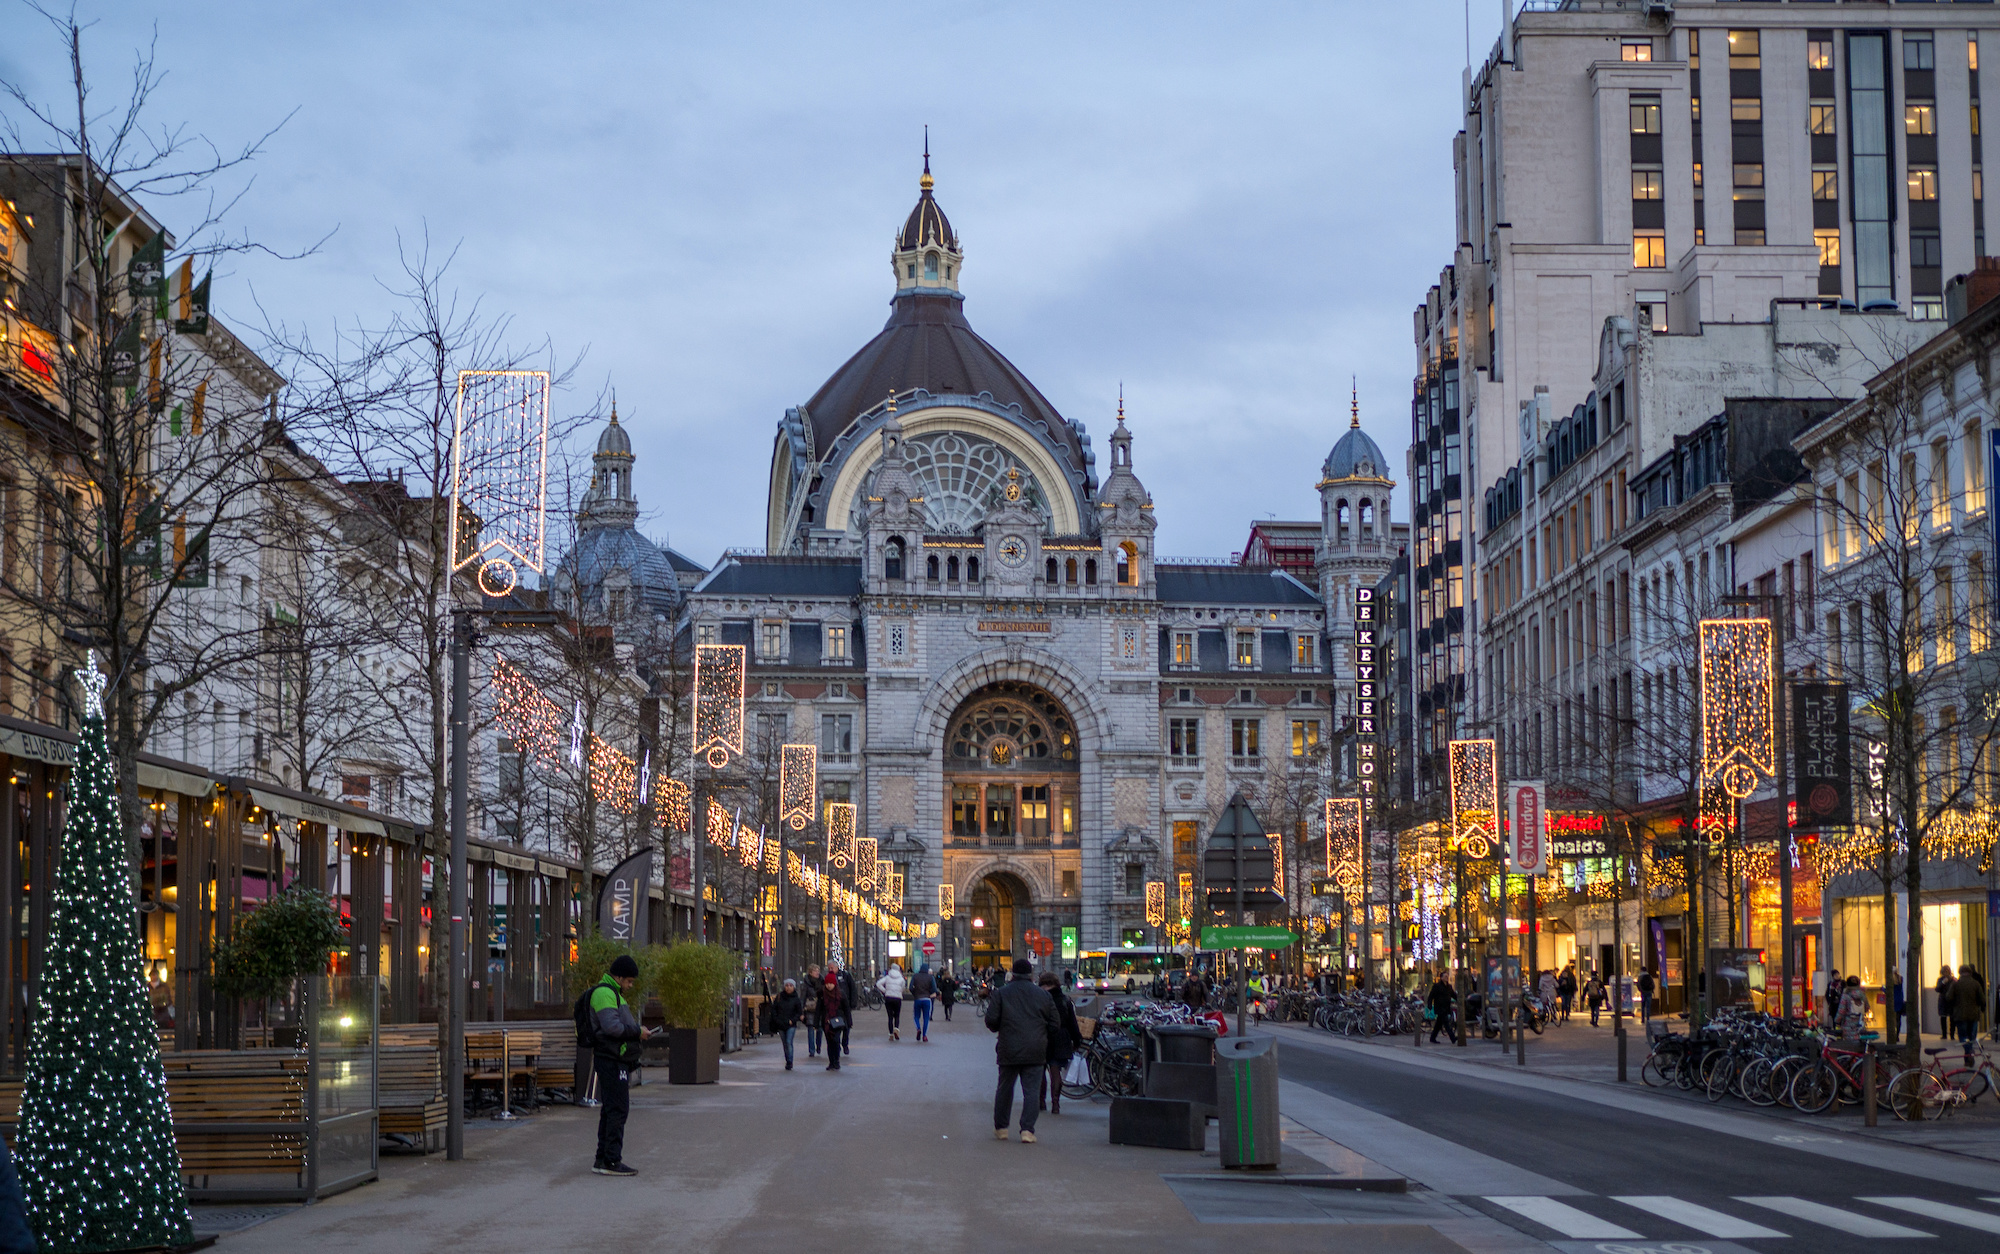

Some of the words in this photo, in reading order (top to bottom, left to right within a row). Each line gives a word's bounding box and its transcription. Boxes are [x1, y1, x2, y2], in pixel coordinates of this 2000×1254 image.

[1358, 589, 1373, 619] DE
[1359, 630, 1374, 732] KEYSER
[1805, 697, 1822, 778] PLANET
[1822, 695, 1839, 778] PARFUM
[1360, 743, 1375, 822] HOTE
[1520, 791, 1535, 849] Kruidvat
[613, 878, 631, 940] KAMP
